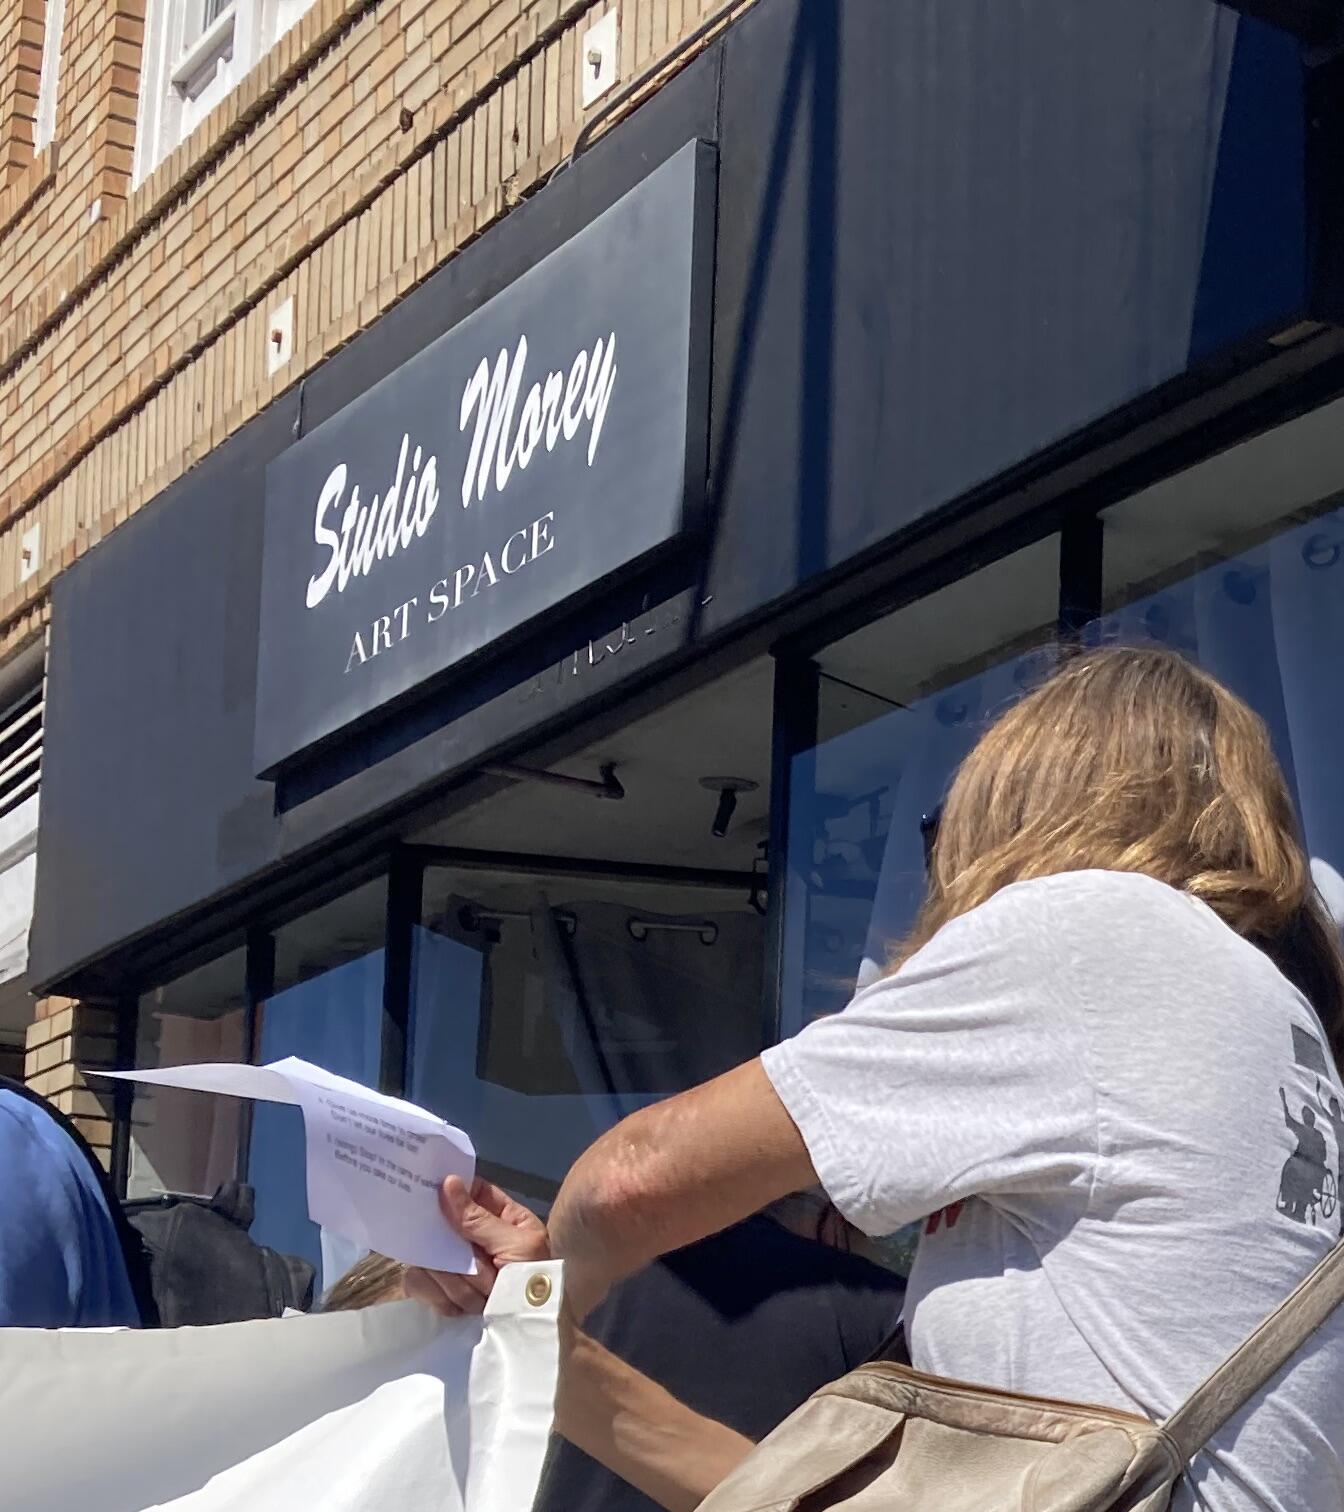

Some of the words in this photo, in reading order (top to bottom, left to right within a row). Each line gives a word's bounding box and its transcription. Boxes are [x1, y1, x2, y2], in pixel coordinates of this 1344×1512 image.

[306, 433, 440, 609] Studio
[343, 597, 418, 674] ART
[427, 510, 555, 623] SPACE
